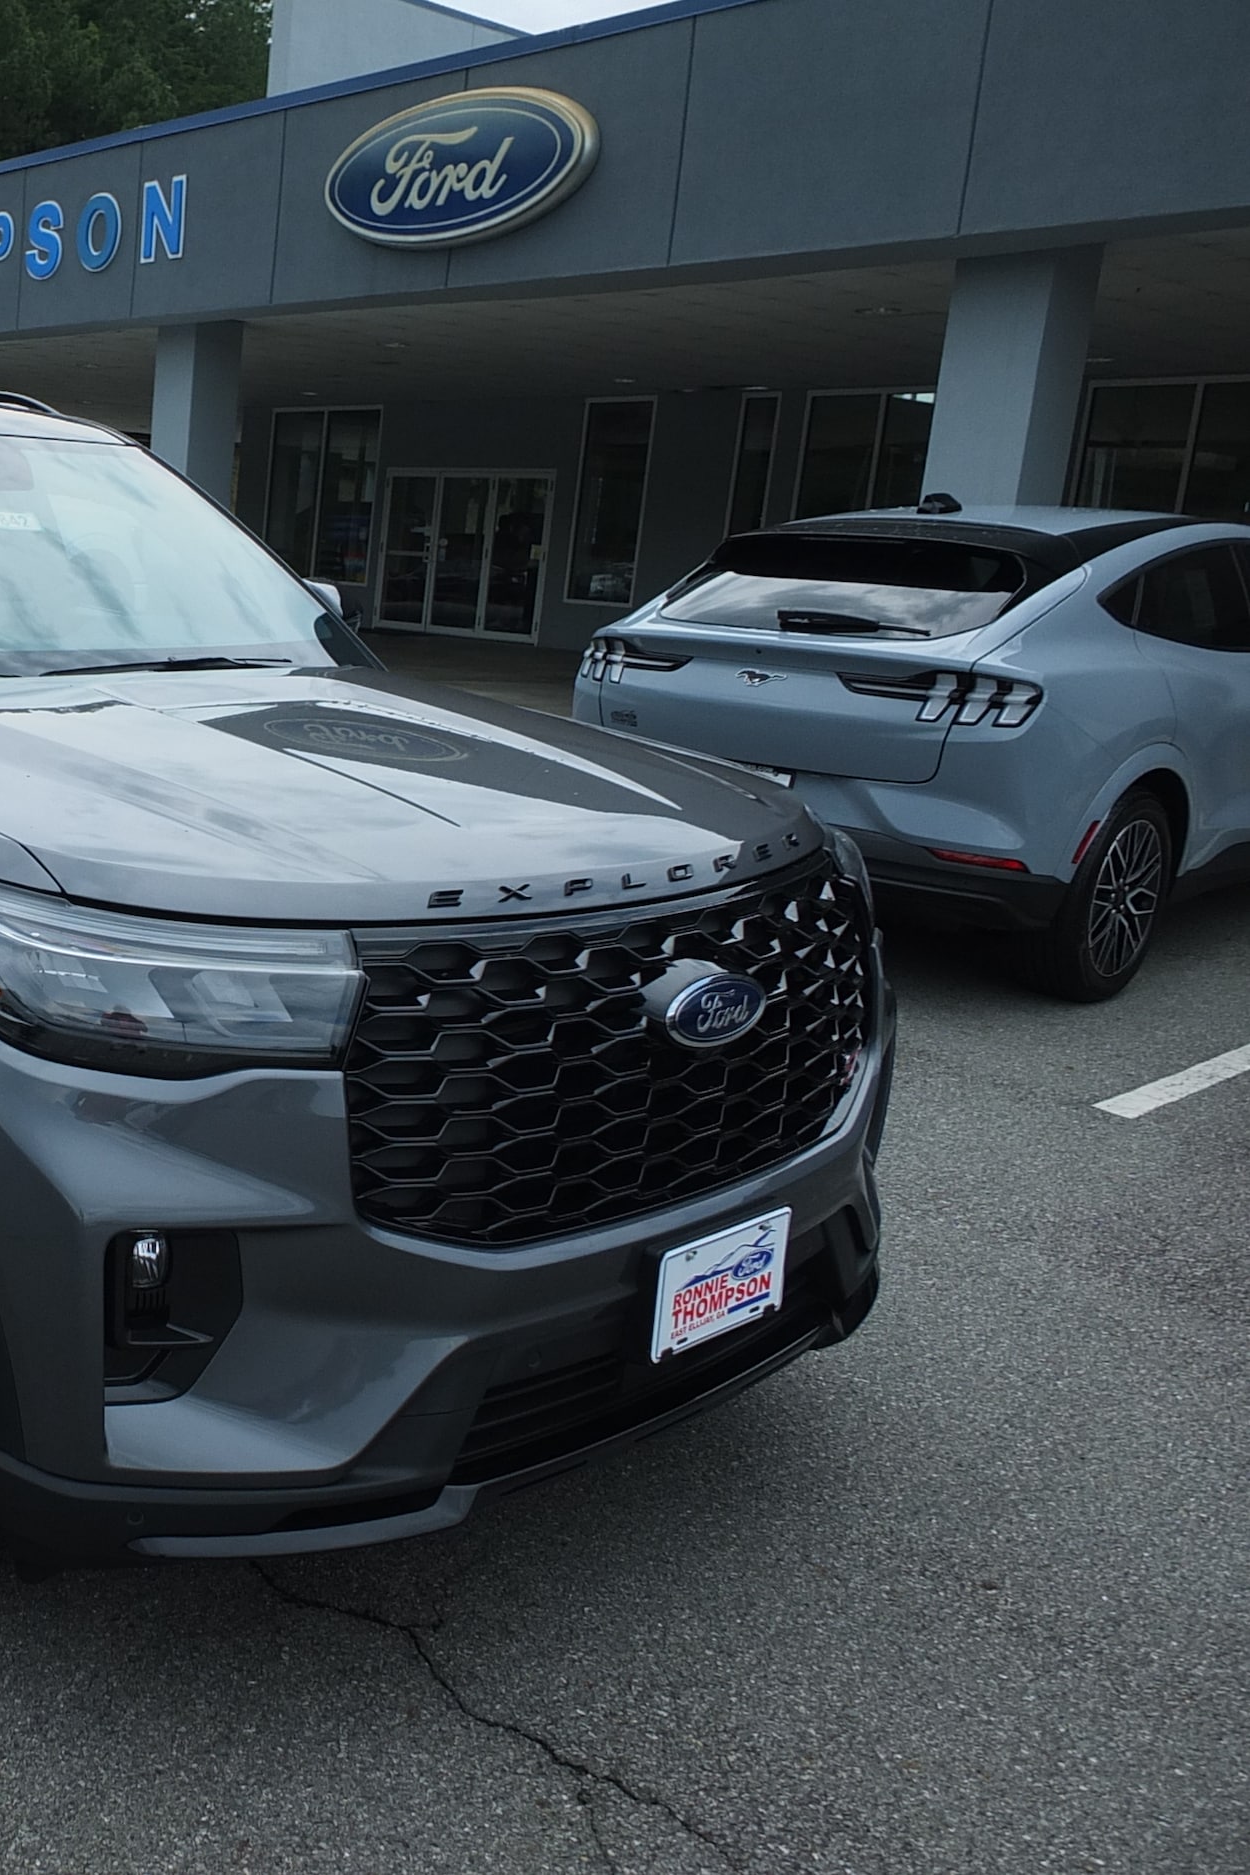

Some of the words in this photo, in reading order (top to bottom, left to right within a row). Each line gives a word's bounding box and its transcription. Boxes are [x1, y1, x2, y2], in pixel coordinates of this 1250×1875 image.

[370, 126, 515, 216] Ford
[427, 832, 801, 909] EXPLORER
[696, 989, 749, 1033] Ford
[737, 1252, 767, 1277] Ford
[672, 1273, 729, 1311] RONNIE
[672, 1271, 772, 1329] THOMPSON
[670, 1326, 687, 1340] EAST
[716, 1310, 726, 1319] GA
